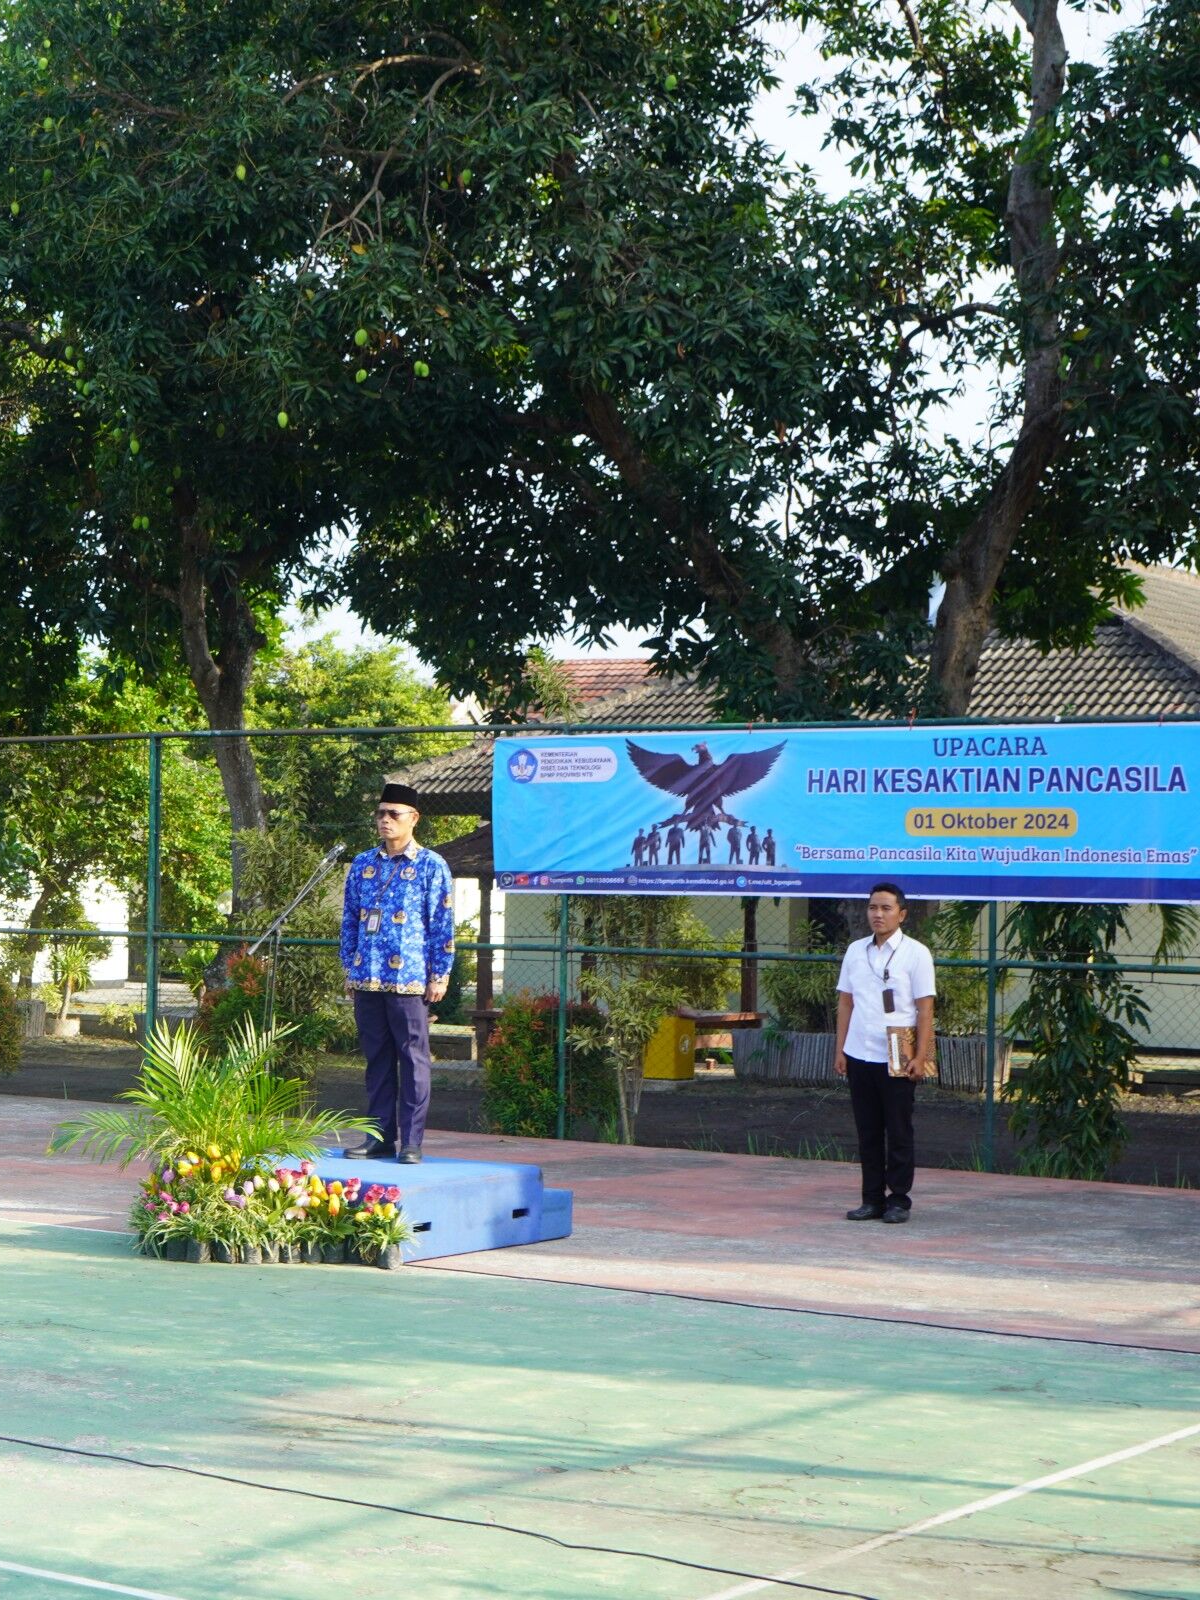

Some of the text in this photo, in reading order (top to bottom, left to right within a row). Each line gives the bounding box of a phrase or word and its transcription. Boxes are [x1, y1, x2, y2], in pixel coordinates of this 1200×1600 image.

[933, 736, 1048, 757] UPACARA
[806, 766, 1187, 794] HARI KESAKTIAN PANCASILA
[913, 812, 1070, 830] 01 Oktober 2024
[869, 846, 942, 862] Pancasila
[946, 847, 977, 862] Kita
[981, 847, 1060, 865] Wujudkan
[1064, 848, 1142, 864] Indonesia
